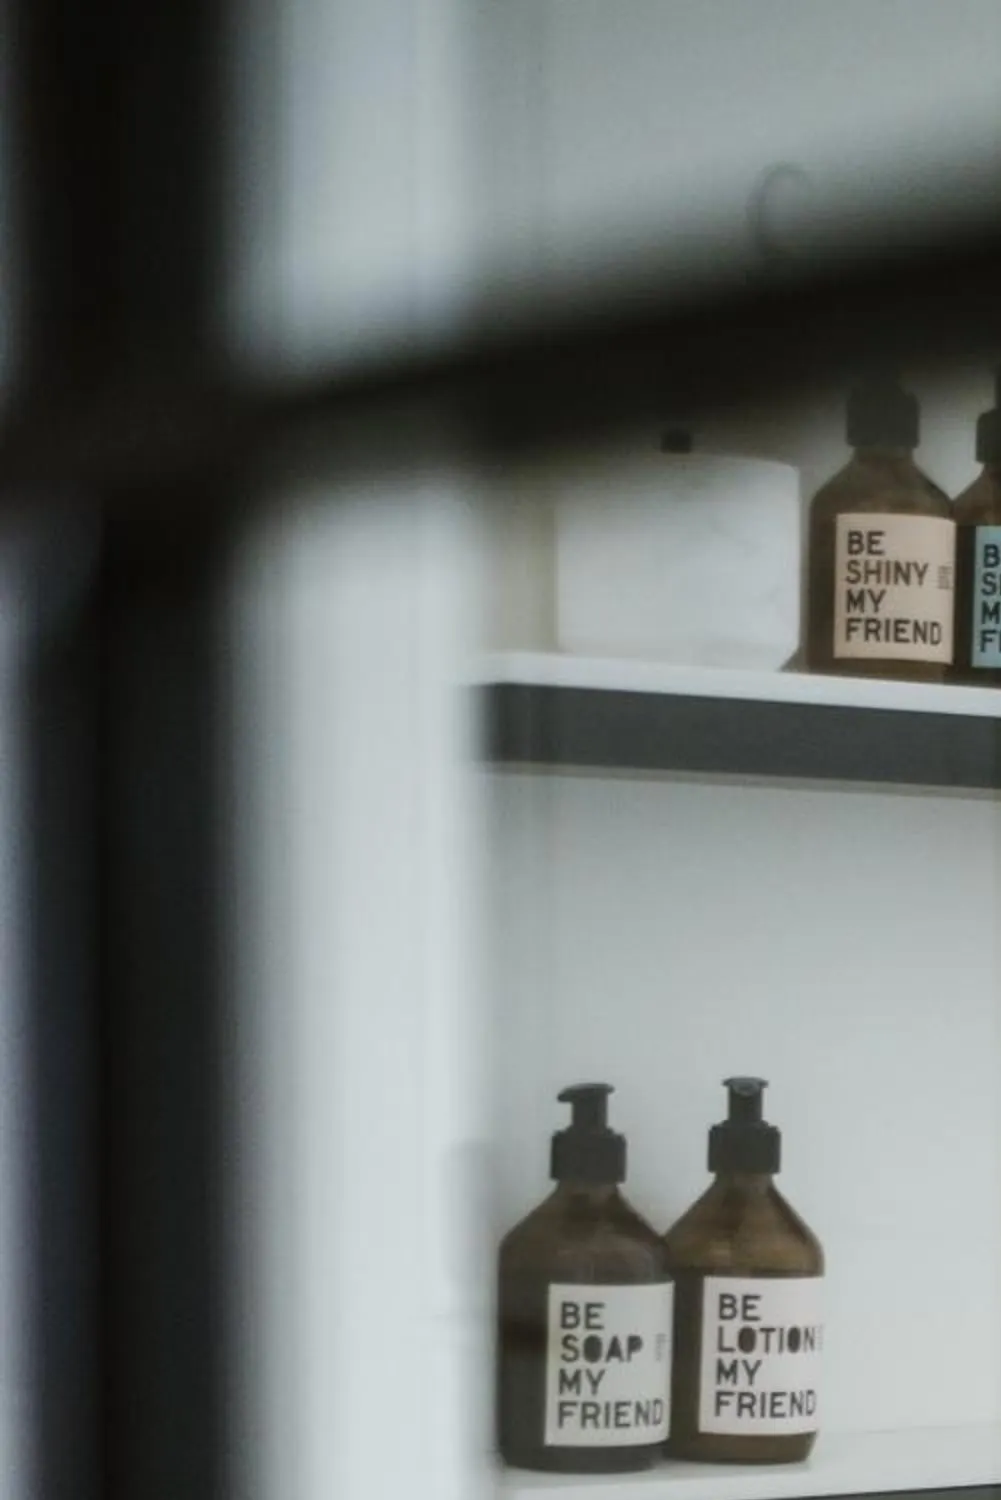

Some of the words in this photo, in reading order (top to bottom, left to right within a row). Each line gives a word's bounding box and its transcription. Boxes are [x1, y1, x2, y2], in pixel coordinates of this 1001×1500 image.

[847, 530, 885, 556] BE
[846, 560, 929, 586] SHINY
[845, 589, 886, 614] MY
[845, 617, 943, 646] FRIEND
[560, 1302, 605, 1331] BE
[718, 1293, 762, 1322] BE
[560, 1334, 643, 1364] SOAP
[717, 1326, 815, 1355] LOTION
[558, 1368, 605, 1397] MY
[715, 1358, 762, 1386] MY
[557, 1399, 664, 1429] FRIEND
[714, 1389, 817, 1419] FRIEND
